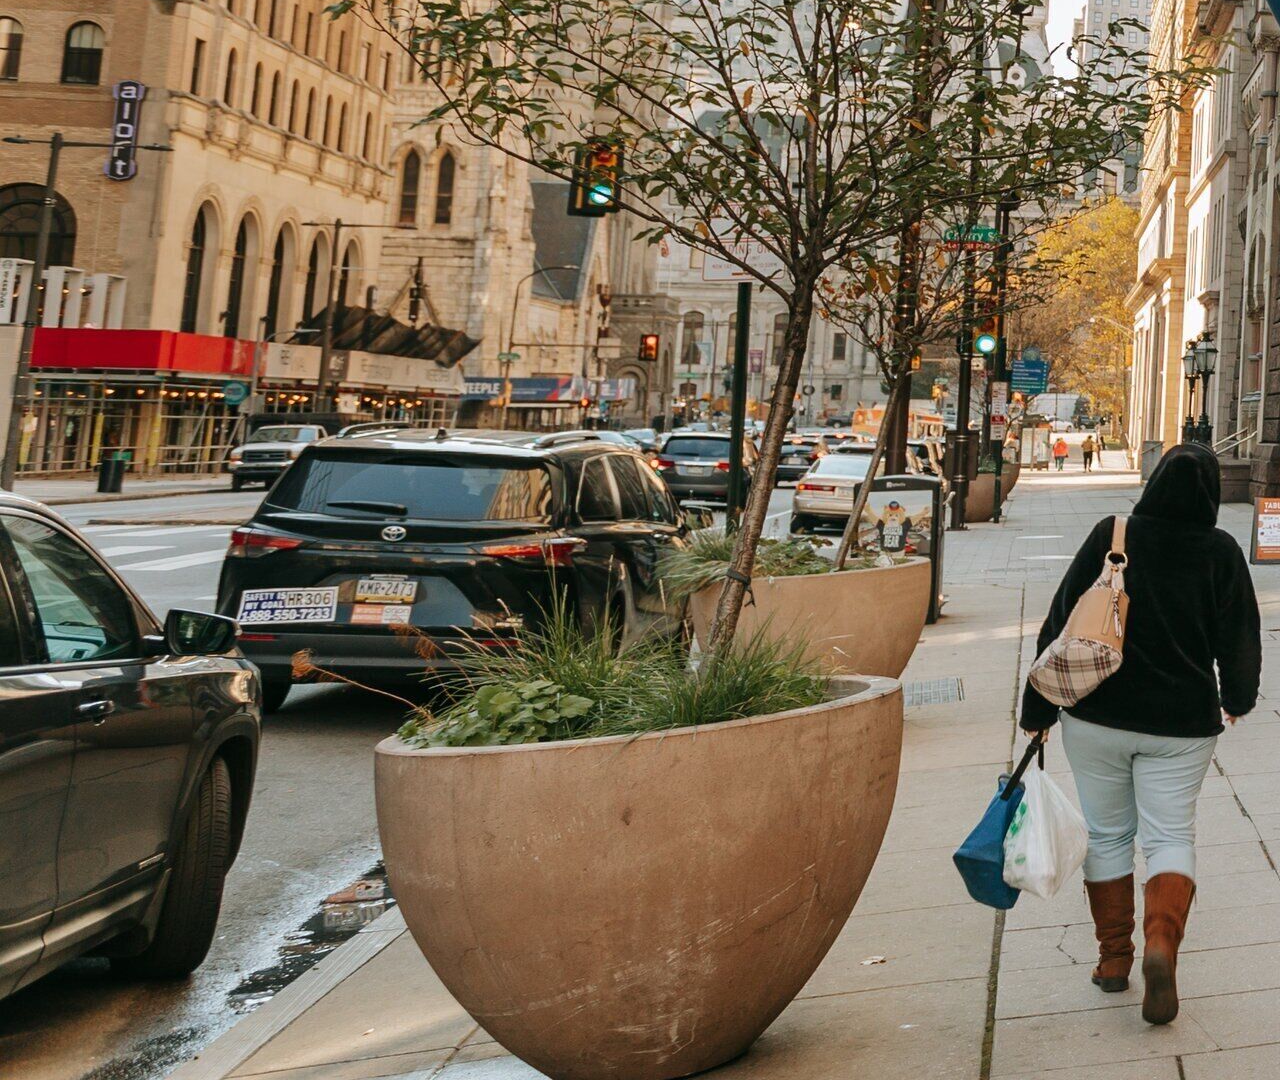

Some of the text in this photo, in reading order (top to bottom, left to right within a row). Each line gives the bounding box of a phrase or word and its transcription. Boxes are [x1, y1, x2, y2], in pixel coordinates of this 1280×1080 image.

[113, 86, 137, 176] aloft
[464, 382, 500, 394] TEEPLE
[245, 592, 286, 602] SAFETY IS
[245, 600, 285, 610] MY GOAL
[241, 608, 330, 621] 1-888-550-7233
